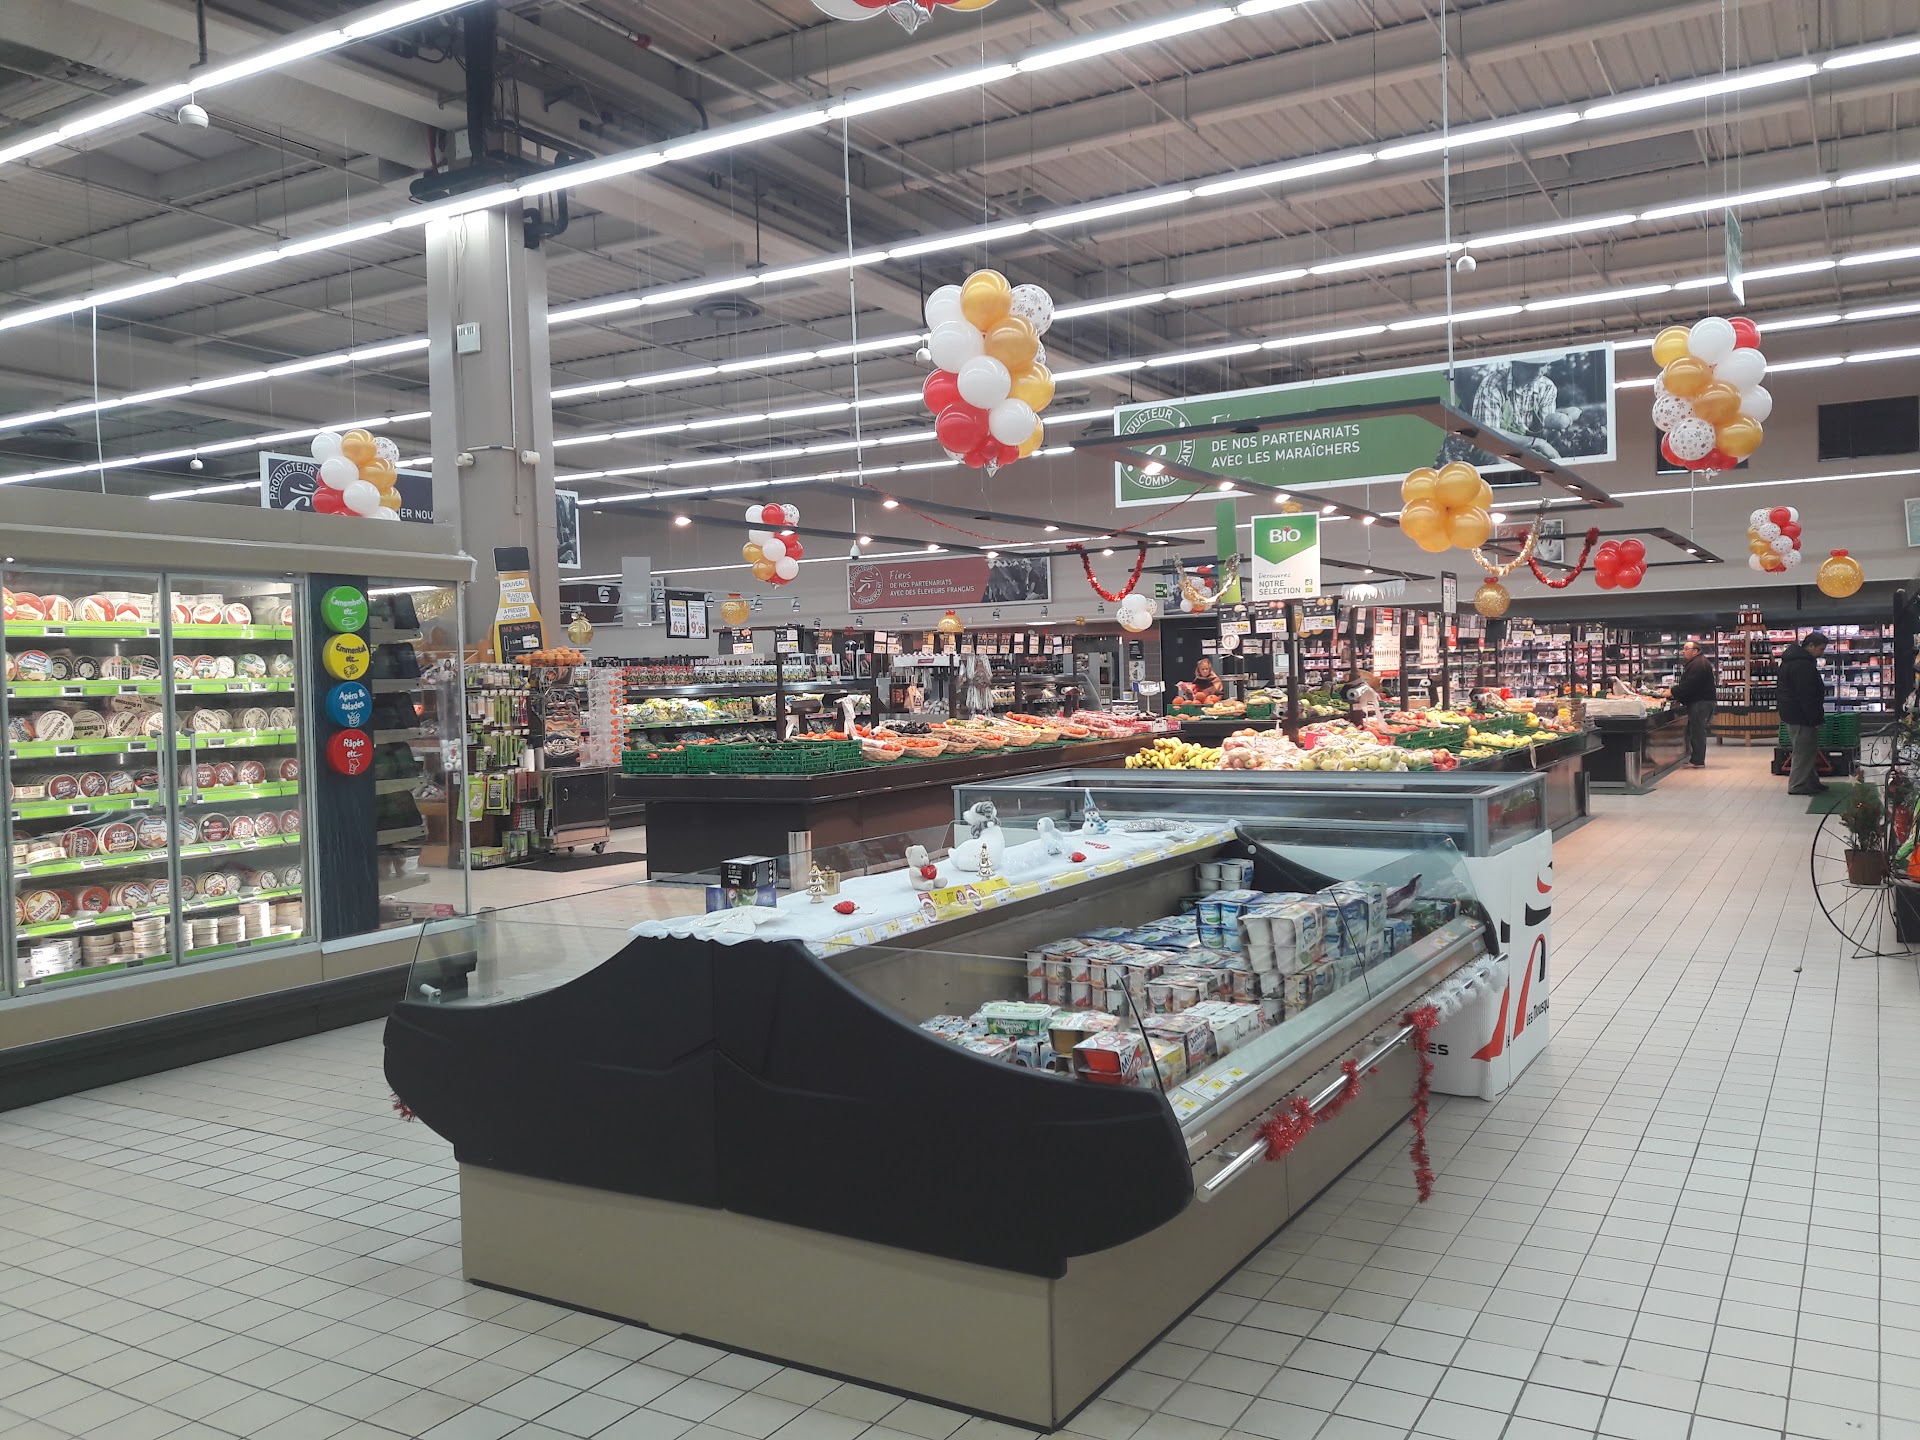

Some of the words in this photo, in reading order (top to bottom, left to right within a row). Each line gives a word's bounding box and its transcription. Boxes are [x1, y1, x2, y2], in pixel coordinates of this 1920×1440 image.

[1124, 407, 1173, 435] DUCTEUR
[1211, 438, 1228, 453] DE
[1232, 433, 1258, 451] NOS
[1262, 424, 1361, 447] PARTENARIATS
[1211, 452, 1244, 469] AVEC
[1247, 450, 1271, 465] LES
[1275, 440, 1361, 461] MARAÎCHERS
[269, 461, 315, 501] PRODUCTEUR
[889, 569, 912, 580] Fiers
[501, 579, 526, 589] NOUVEAU
[898, 581, 911, 589] NOS
[911, 579, 953, 588] PARTENARIATS
[1258, 579, 1285, 587] NOTRE
[889, 589, 904, 597] AVEC
[905, 588, 917, 596] DES
[946, 585, 975, 593] FRANÇAIS
[330, 595, 366, 608] Camembert
[335, 642, 368, 655] Emmental
[338, 690, 358, 703] Apéro
[358, 688, 366, 698] &
[340, 699, 365, 711] salades
[343, 737, 365, 748] Râpés
